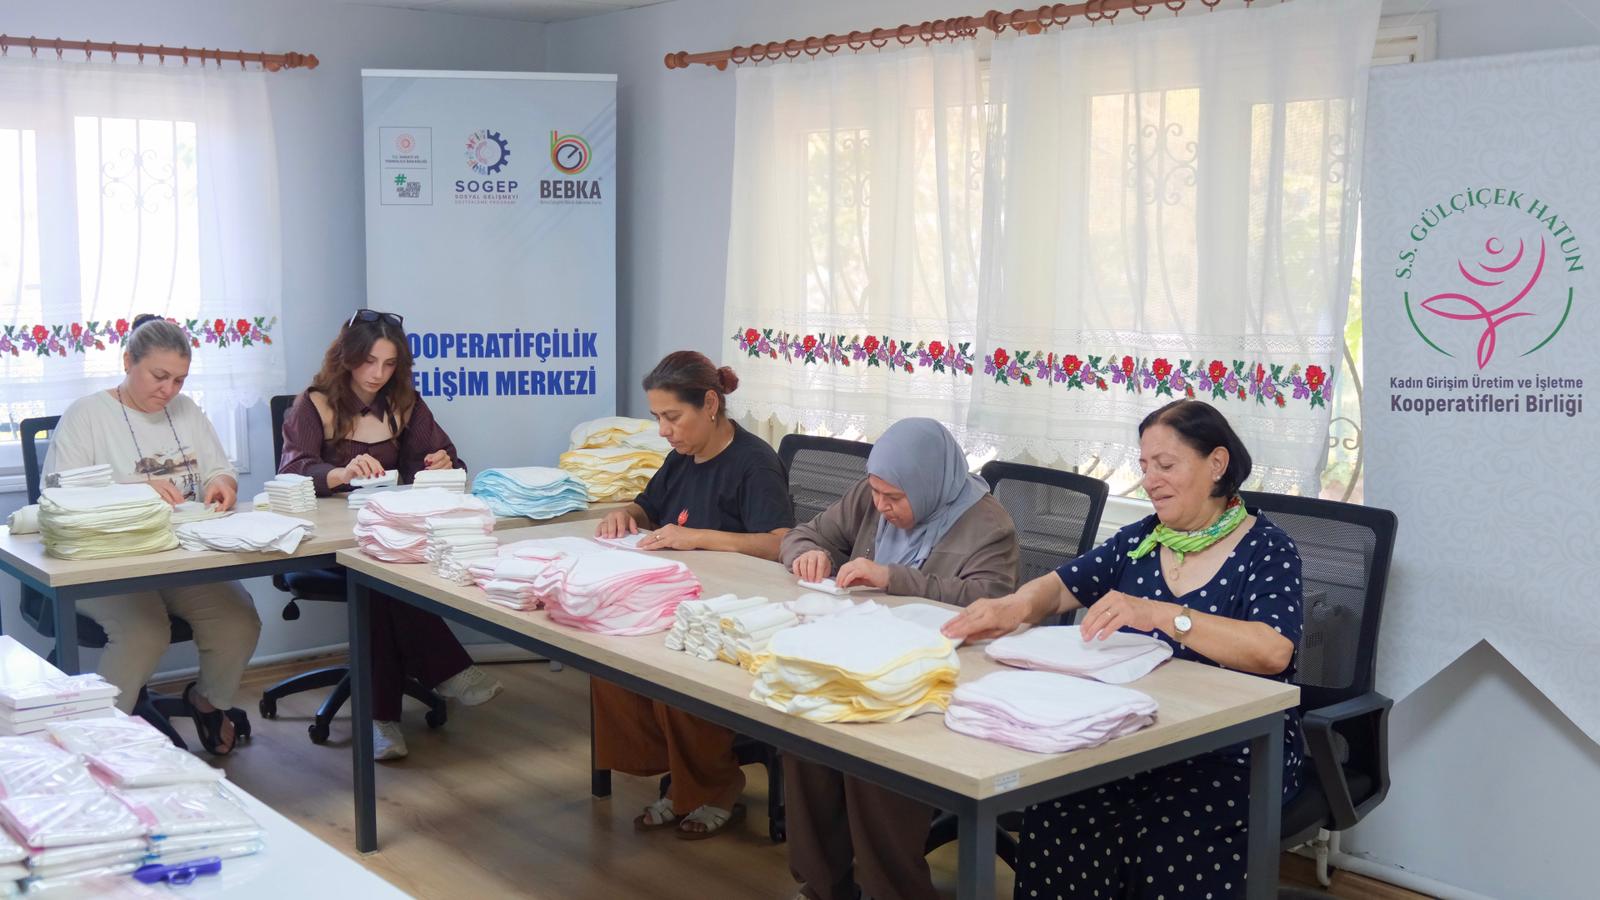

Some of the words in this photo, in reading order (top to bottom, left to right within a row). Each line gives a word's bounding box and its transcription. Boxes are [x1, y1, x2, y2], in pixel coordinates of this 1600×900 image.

[455, 180, 518, 193] SOGEP
[540, 180, 602, 199] BEBKA
[1395, 248, 1417, 279] S.S.
[1410, 187, 1524, 242] GÜLÇİÇEK
[1527, 199, 1584, 272] HATUN
[406, 328, 598, 363] OOPERATİFÇİLİK
[412, 367, 489, 401] ELİŞİM
[495, 366, 597, 396] MERKEZİ
[1390, 376, 1423, 389] Kadın
[1426, 376, 1469, 391] Girişim
[1472, 374, 1514, 389] Üretim
[1517, 378, 1532, 388] ve
[1535, 373, 1584, 391] İşletme
[1390, 394, 1520, 416] Kooperatifleri
[1525, 394, 1583, 417] Birliği
